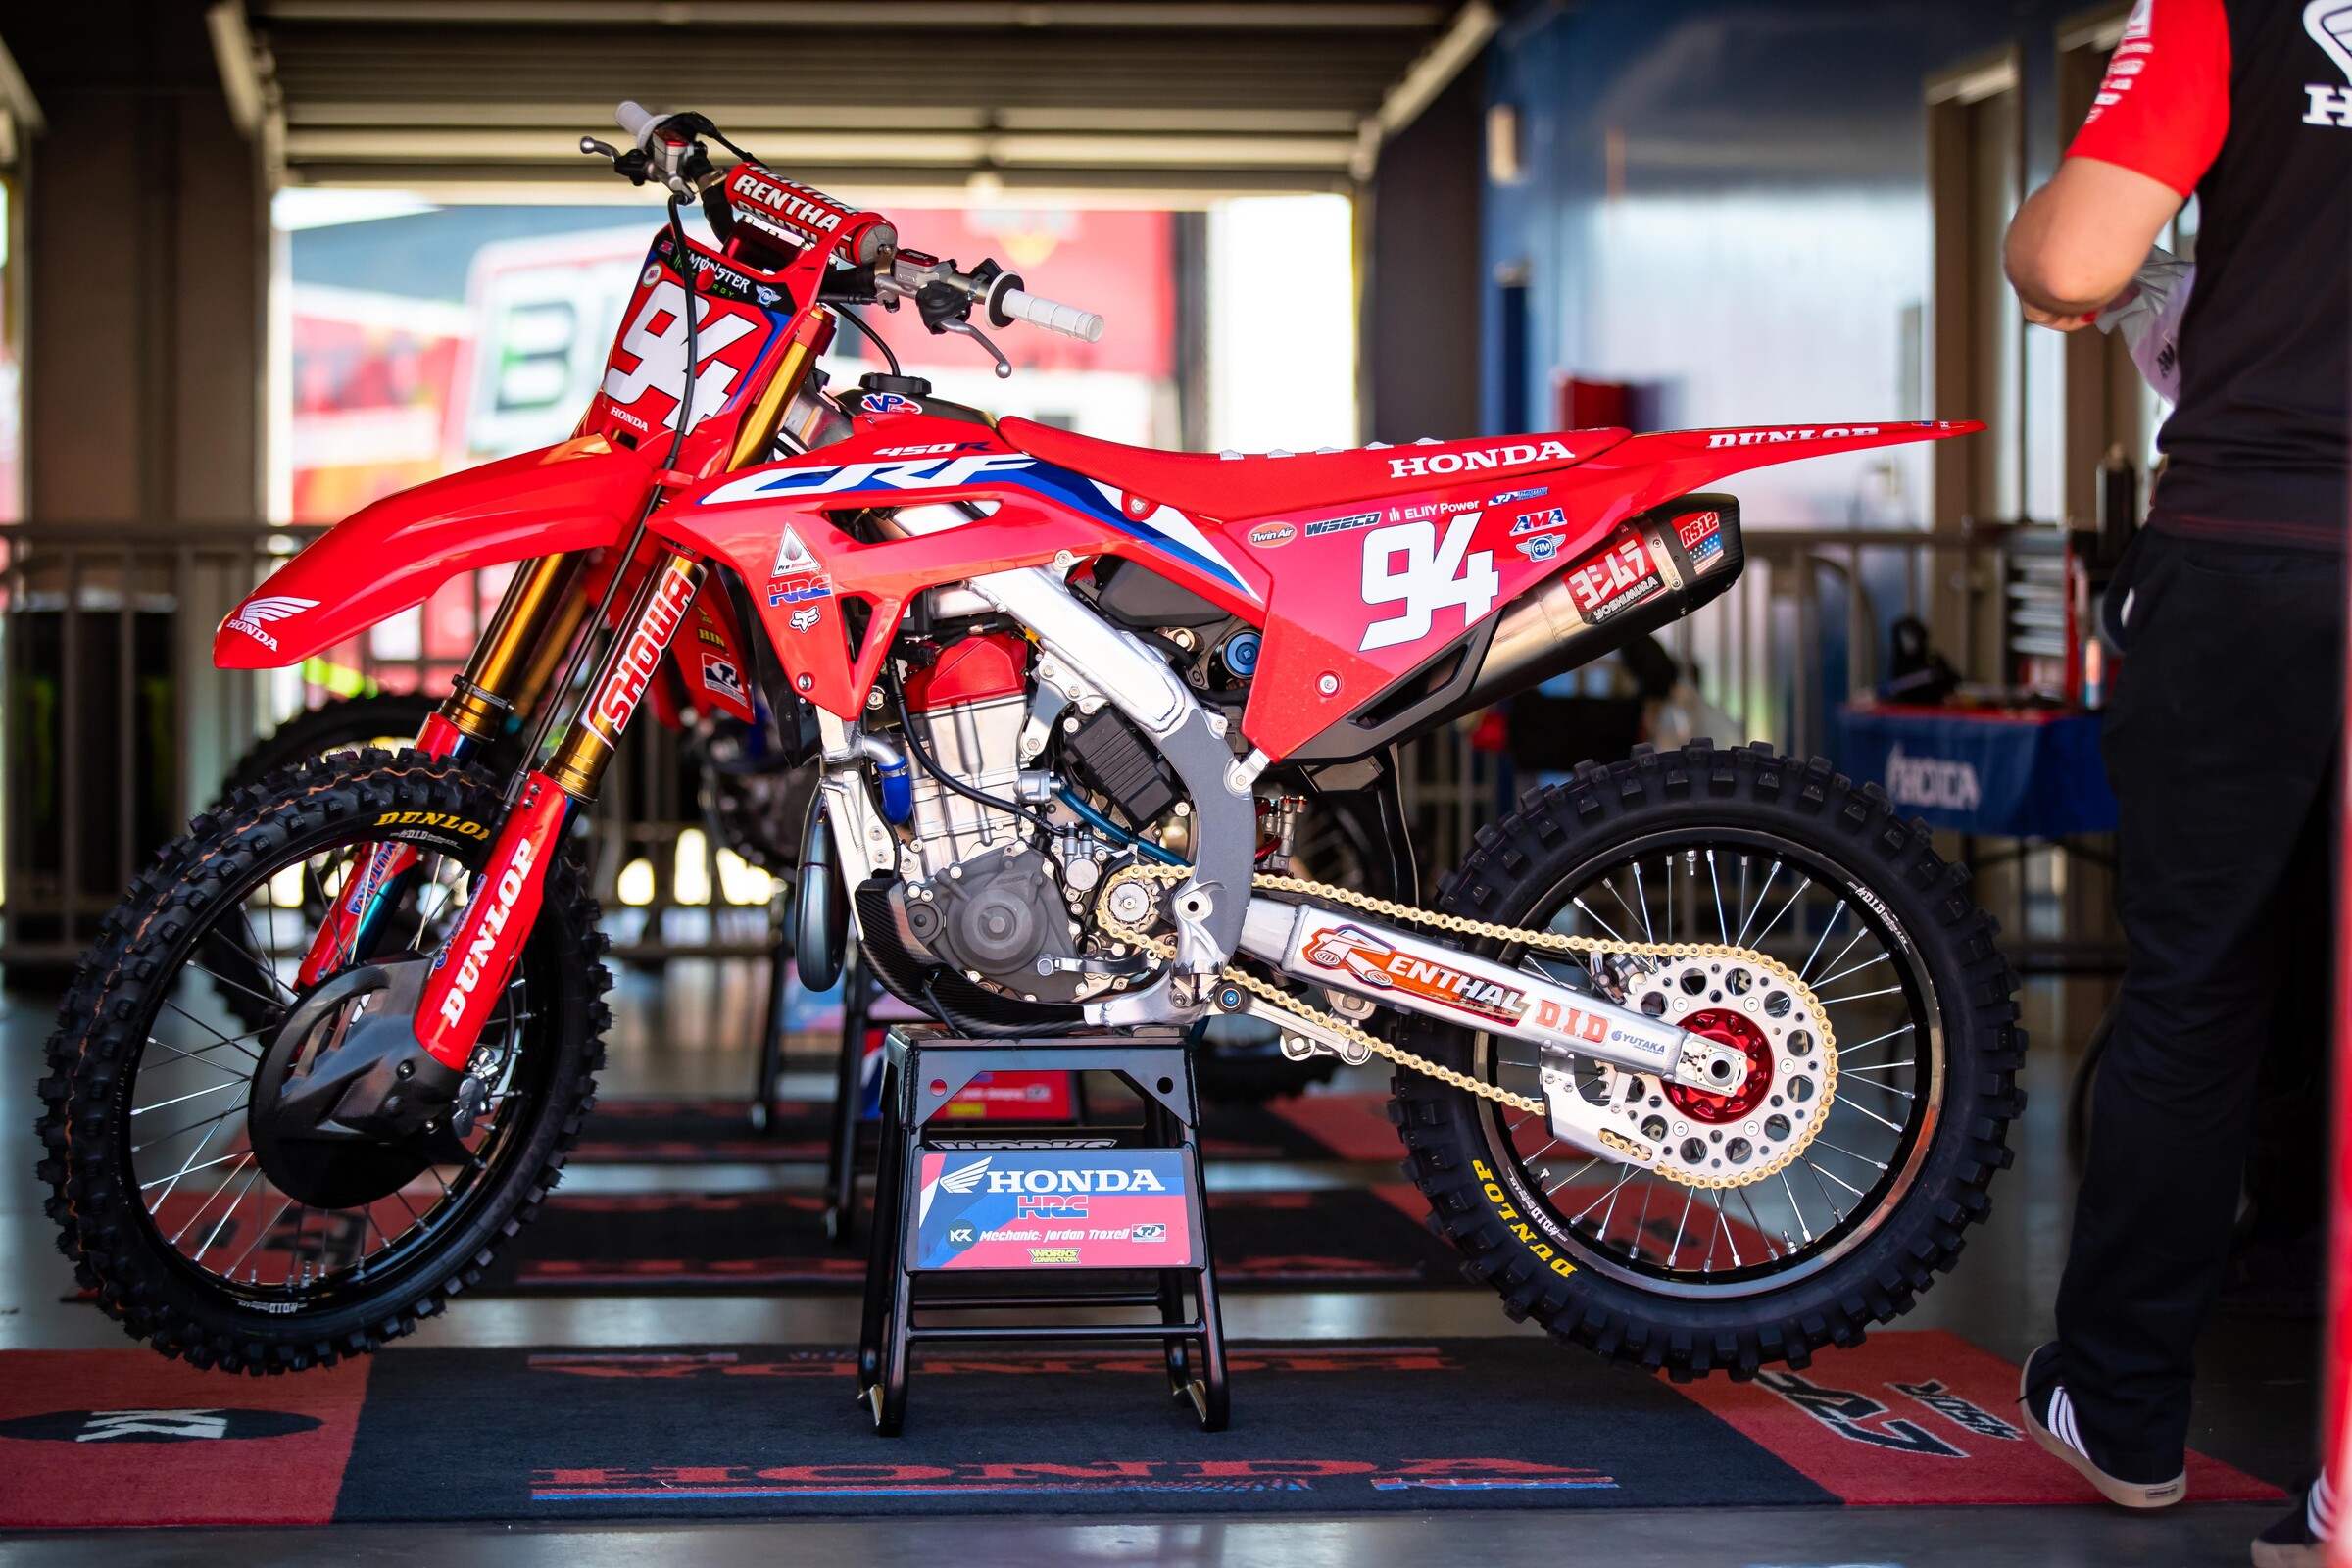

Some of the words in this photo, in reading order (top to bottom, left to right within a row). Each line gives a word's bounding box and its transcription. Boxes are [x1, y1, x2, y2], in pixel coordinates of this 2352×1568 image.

[733, 174, 851, 242] RENTHA
[603, 279, 760, 437] 94
[610, 405, 649, 433] HONDA
[1388, 441, 1575, 478] HONDA
[701, 454, 1039, 505] CRF
[1440, 500, 1480, 515] Power
[1512, 508, 1565, 533] AMA
[1252, 531, 1277, 542] Twin
[1278, 527, 1295, 538] Air
[1534, 542, 1550, 553] FIM
[766, 573, 833, 608] HRC
[1358, 511, 1500, 652] 94
[1568, 539, 1646, 610] ヨシムラ
[1592, 575, 1659, 620] YOSHIMURA
[226, 618, 278, 652] HONDA
[598, 566, 697, 735] SHOWA
[440, 837, 534, 1028] DUNLOP
[1623, 1034, 1665, 1054] YUTAKA
[987, 1169, 1166, 1193] HONDA
[1017, 1195, 1089, 1219] HRC
[1472, 1160, 1578, 1278] DUNLOP
[979, 1230, 1042, 1242] Mechanic:
[1044, 1229, 1084, 1243] Jordan
[1089, 1228, 1131, 1241] Troxell
[1032, 1249, 1078, 1257] WORKS
[530, 1457, 1600, 1485] HONDA
